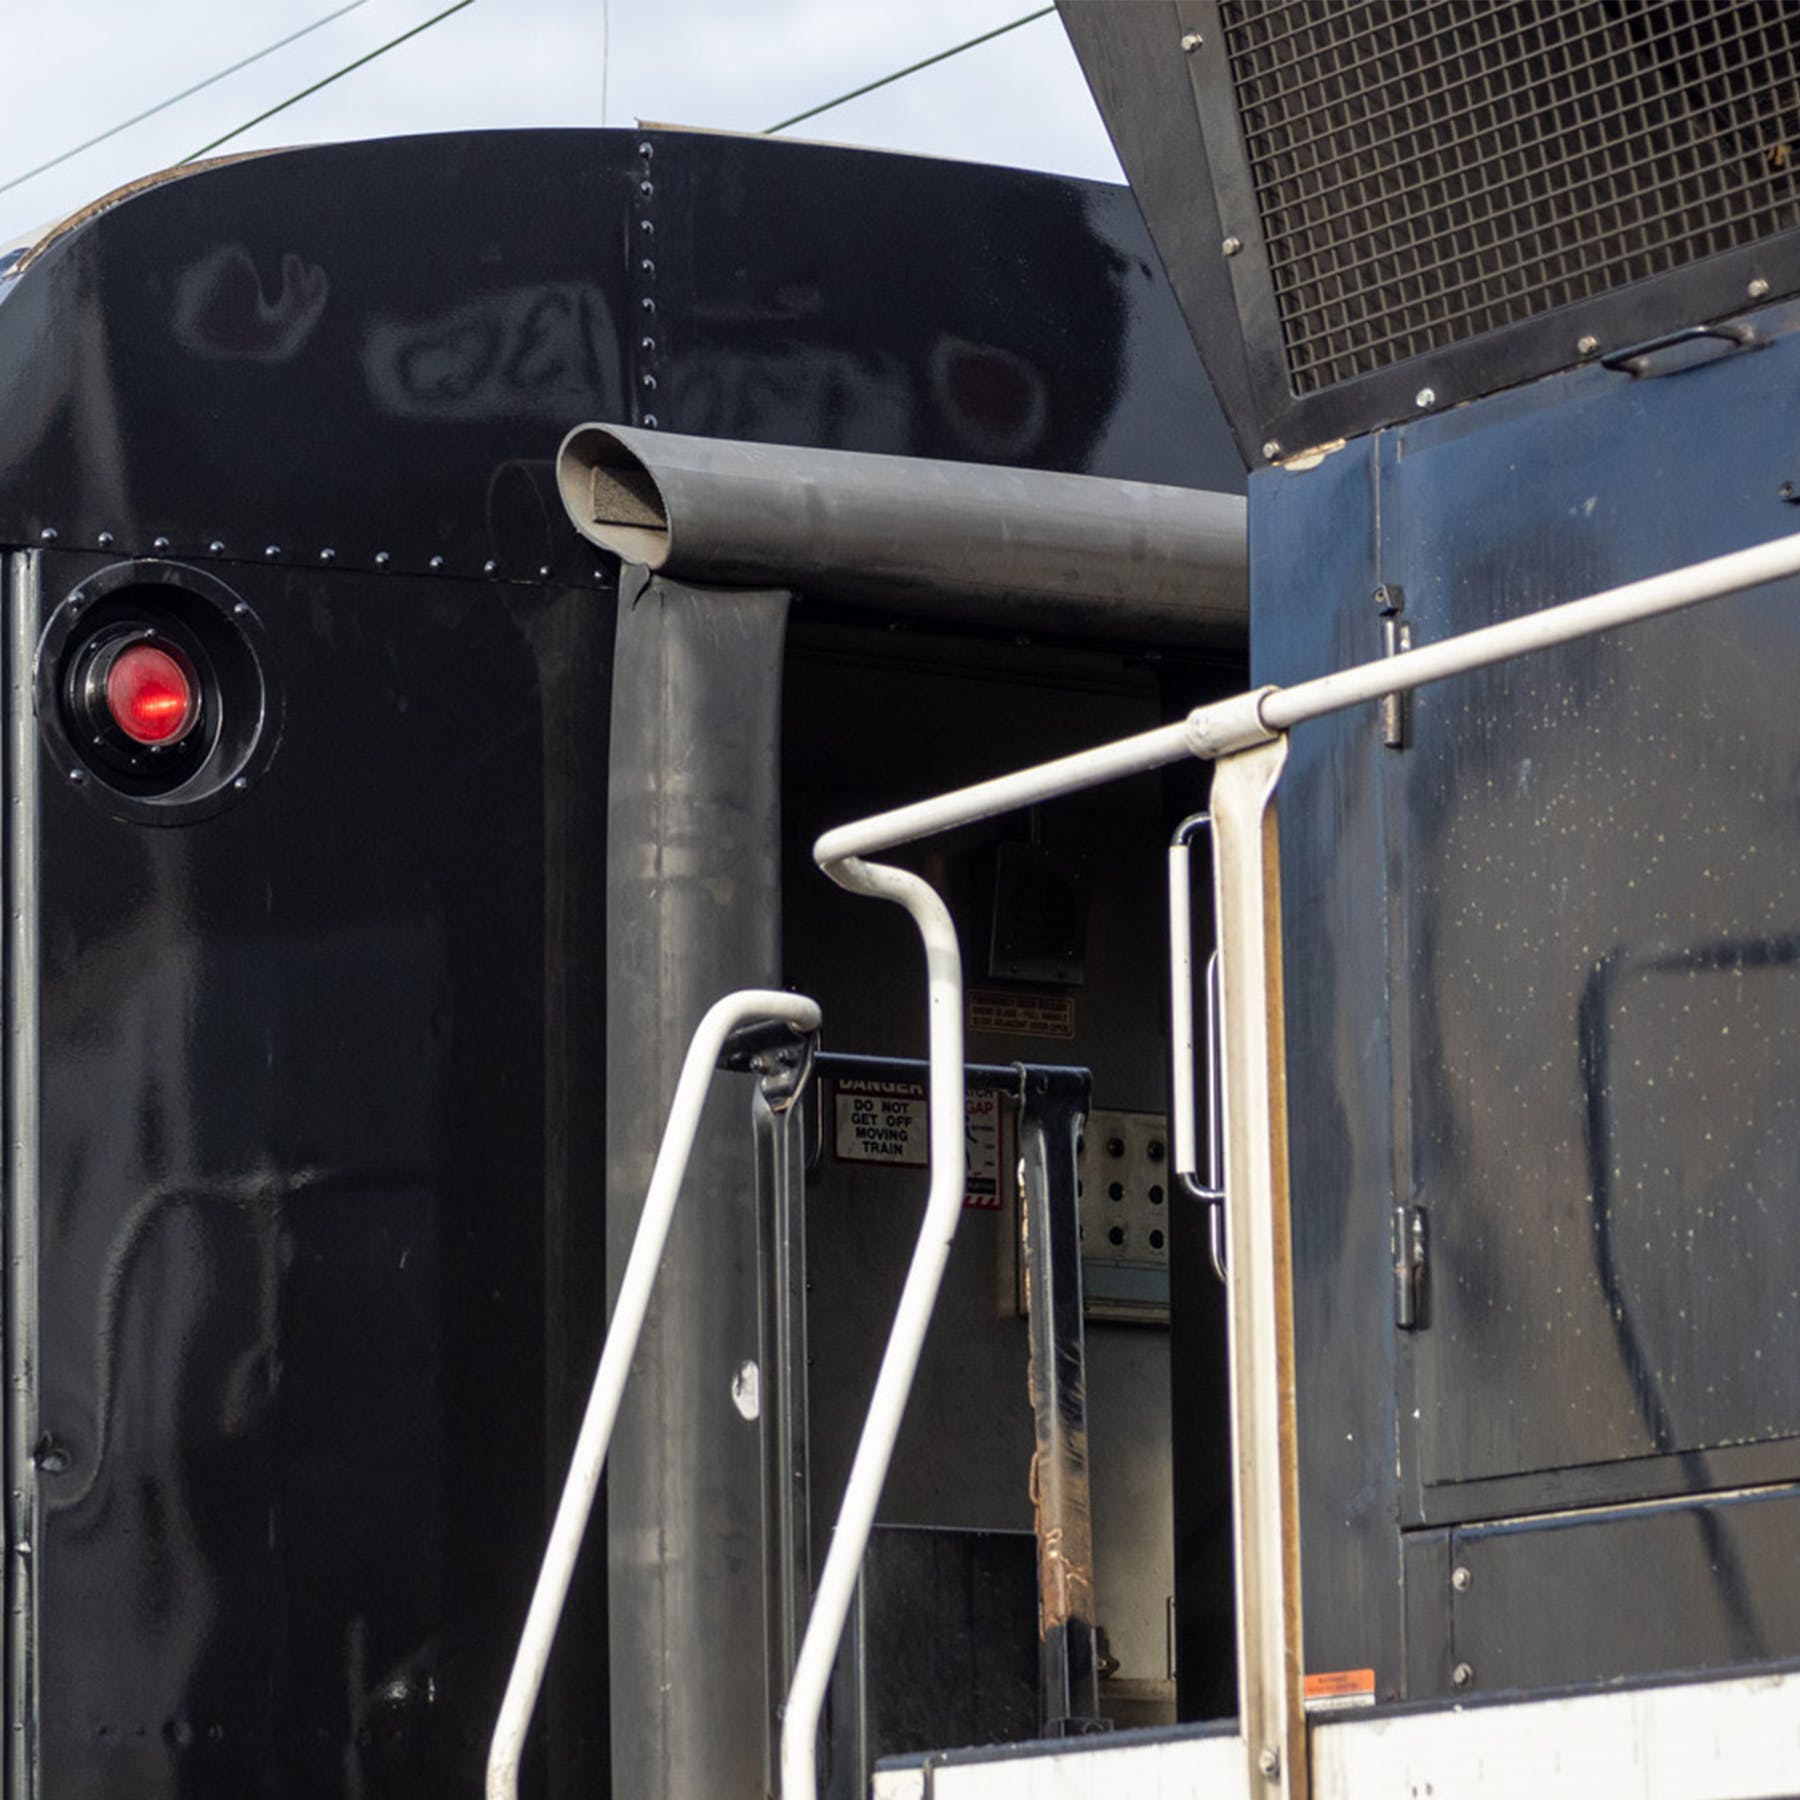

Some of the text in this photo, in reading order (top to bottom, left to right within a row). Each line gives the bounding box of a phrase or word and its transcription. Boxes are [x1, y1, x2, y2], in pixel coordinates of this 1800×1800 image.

[854, 1099, 909, 1114] DO NOT
[852, 1113, 912, 1128] GET OFF
[856, 1127, 908, 1142] MOVING
[863, 1141, 903, 1155] TRAIN
